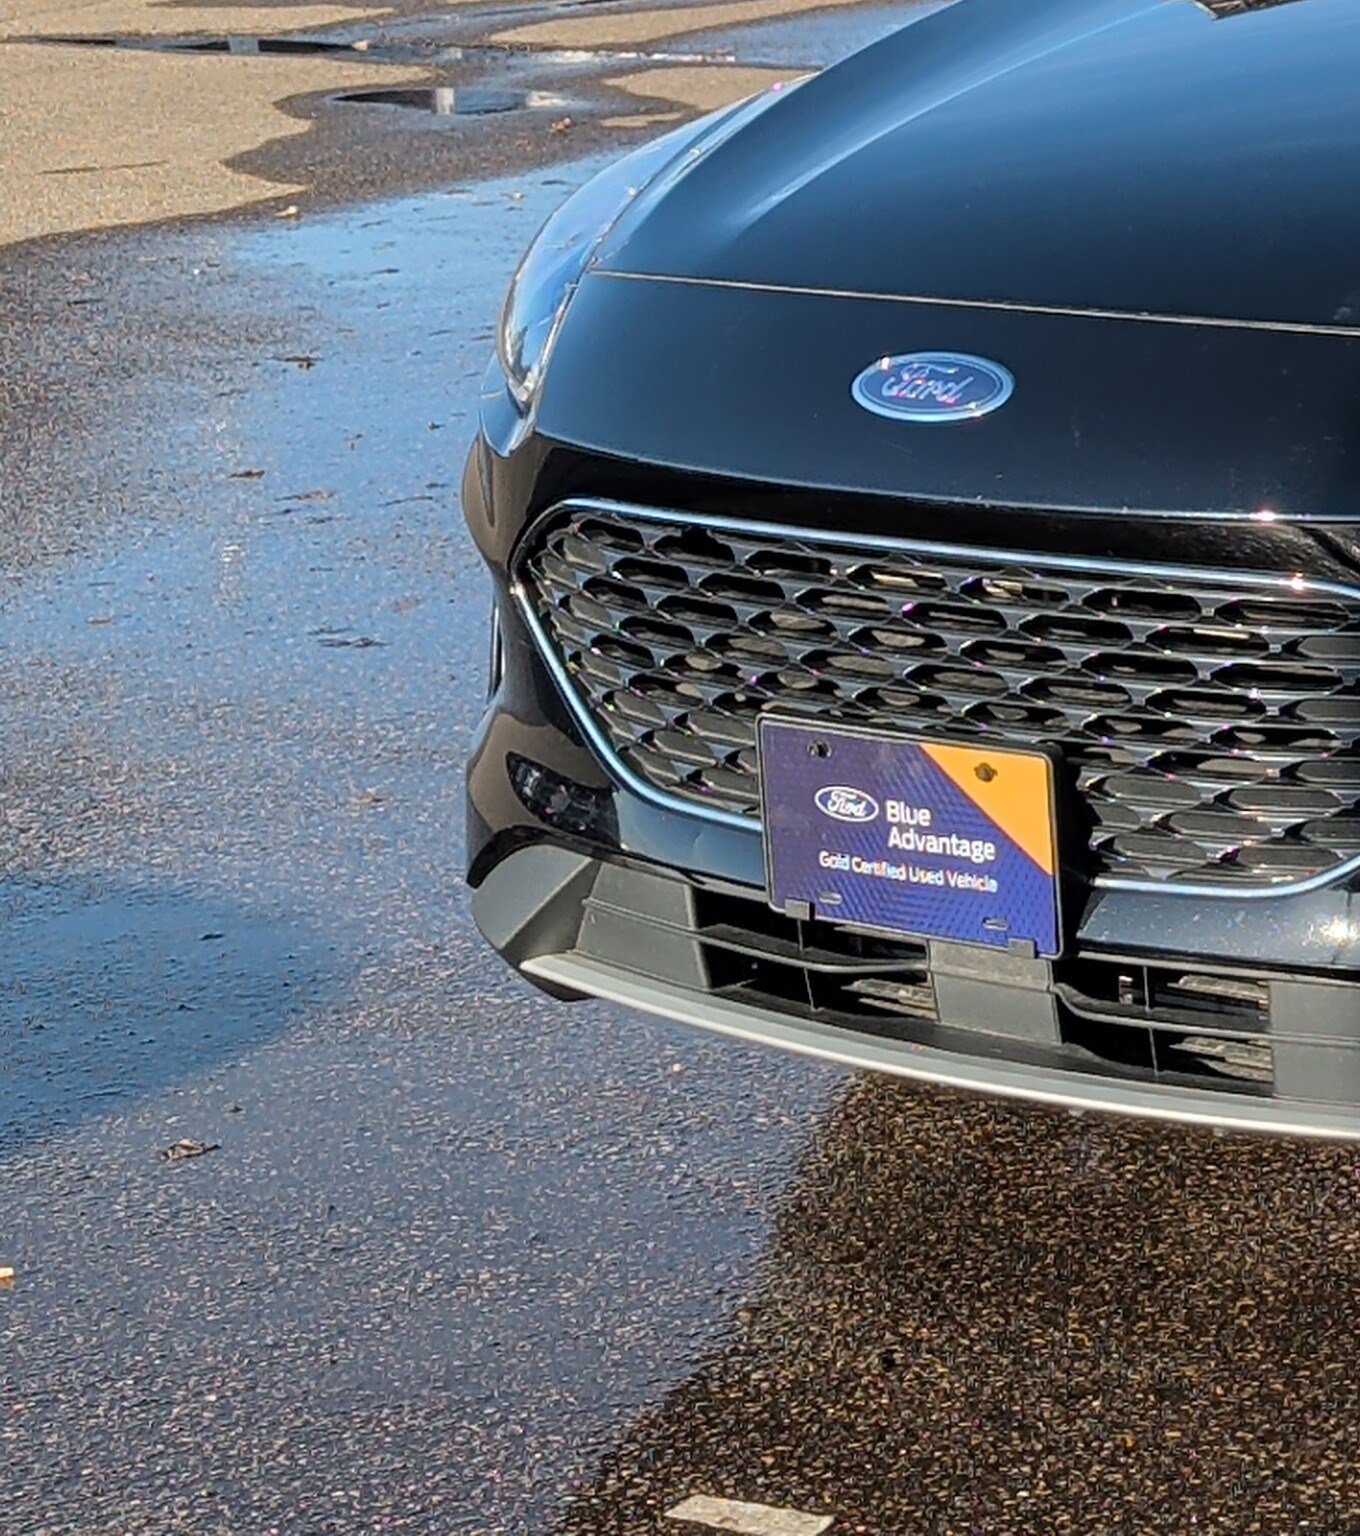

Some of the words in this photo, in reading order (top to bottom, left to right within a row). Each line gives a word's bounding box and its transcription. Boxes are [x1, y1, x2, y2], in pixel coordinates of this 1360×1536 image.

[885, 800, 931, 826] Blue
[888, 825, 996, 864] Advantage
[818, 850, 850, 871] Gold
[851, 856, 907, 882] Certified
[909, 866, 945, 886] Used
[946, 869, 998, 893] Vehicle
